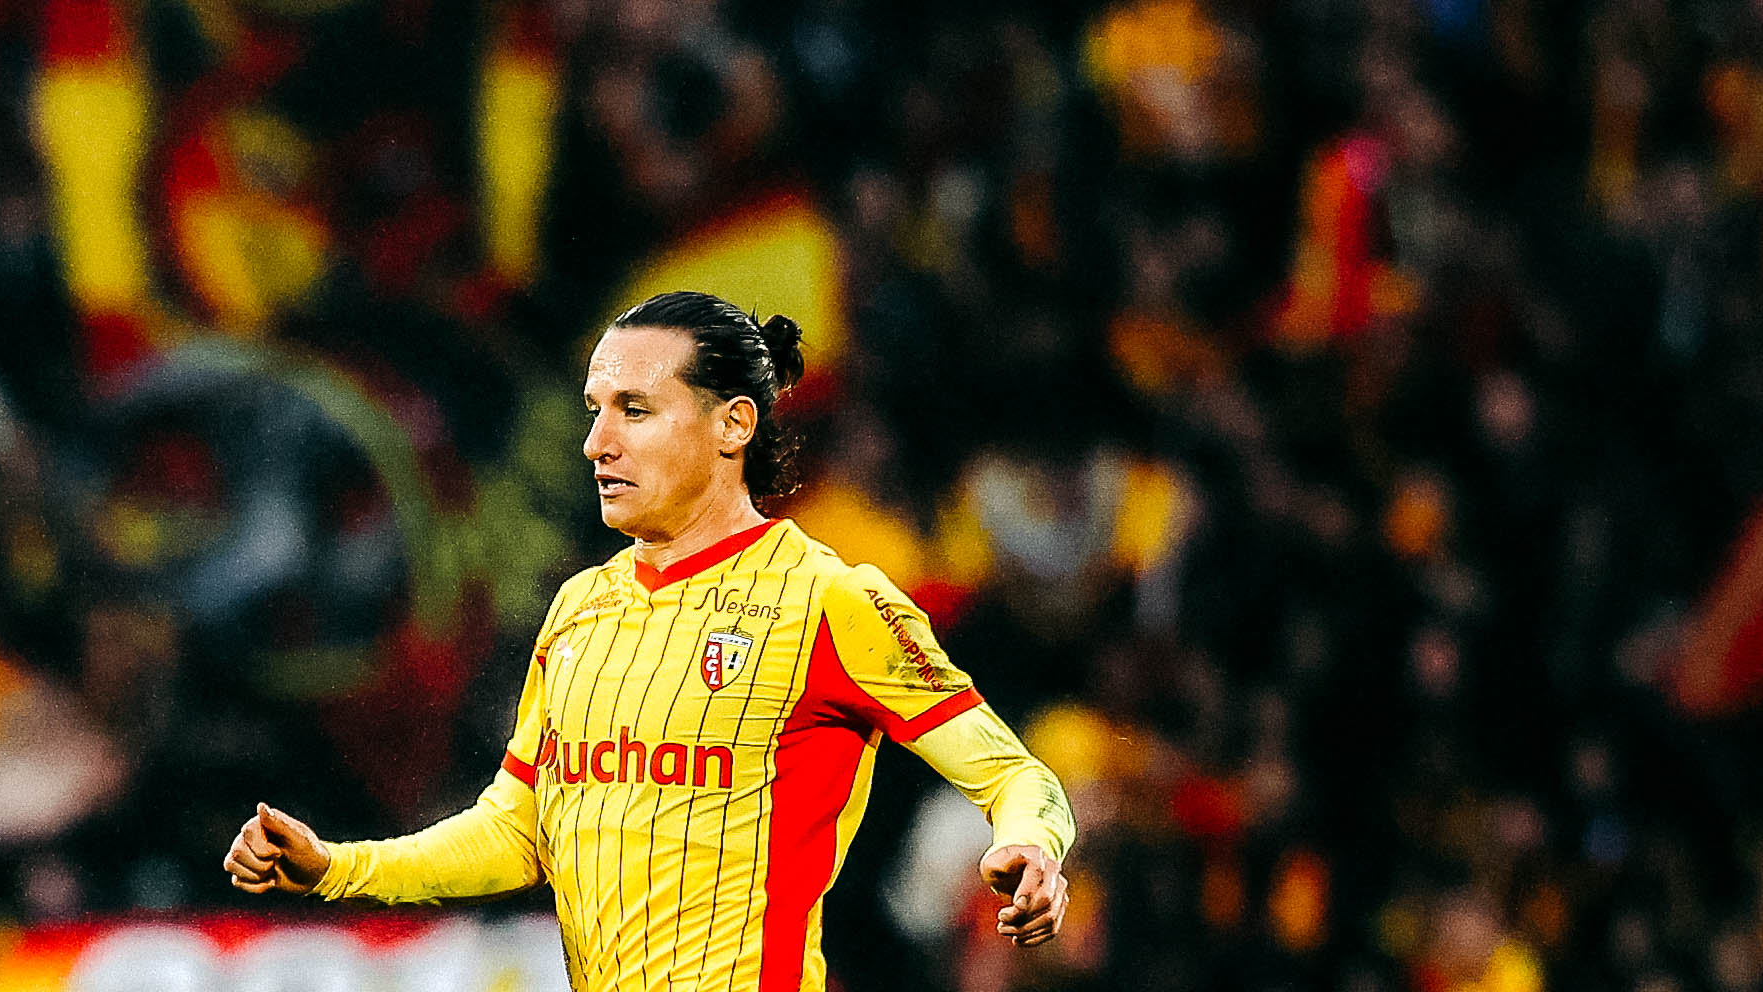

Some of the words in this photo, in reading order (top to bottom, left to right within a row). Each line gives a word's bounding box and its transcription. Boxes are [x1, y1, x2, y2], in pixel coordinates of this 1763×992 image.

[693, 586, 782, 620] Nexans
[863, 588, 944, 693] AUSHOPPING
[705, 644, 720, 686] RCL
